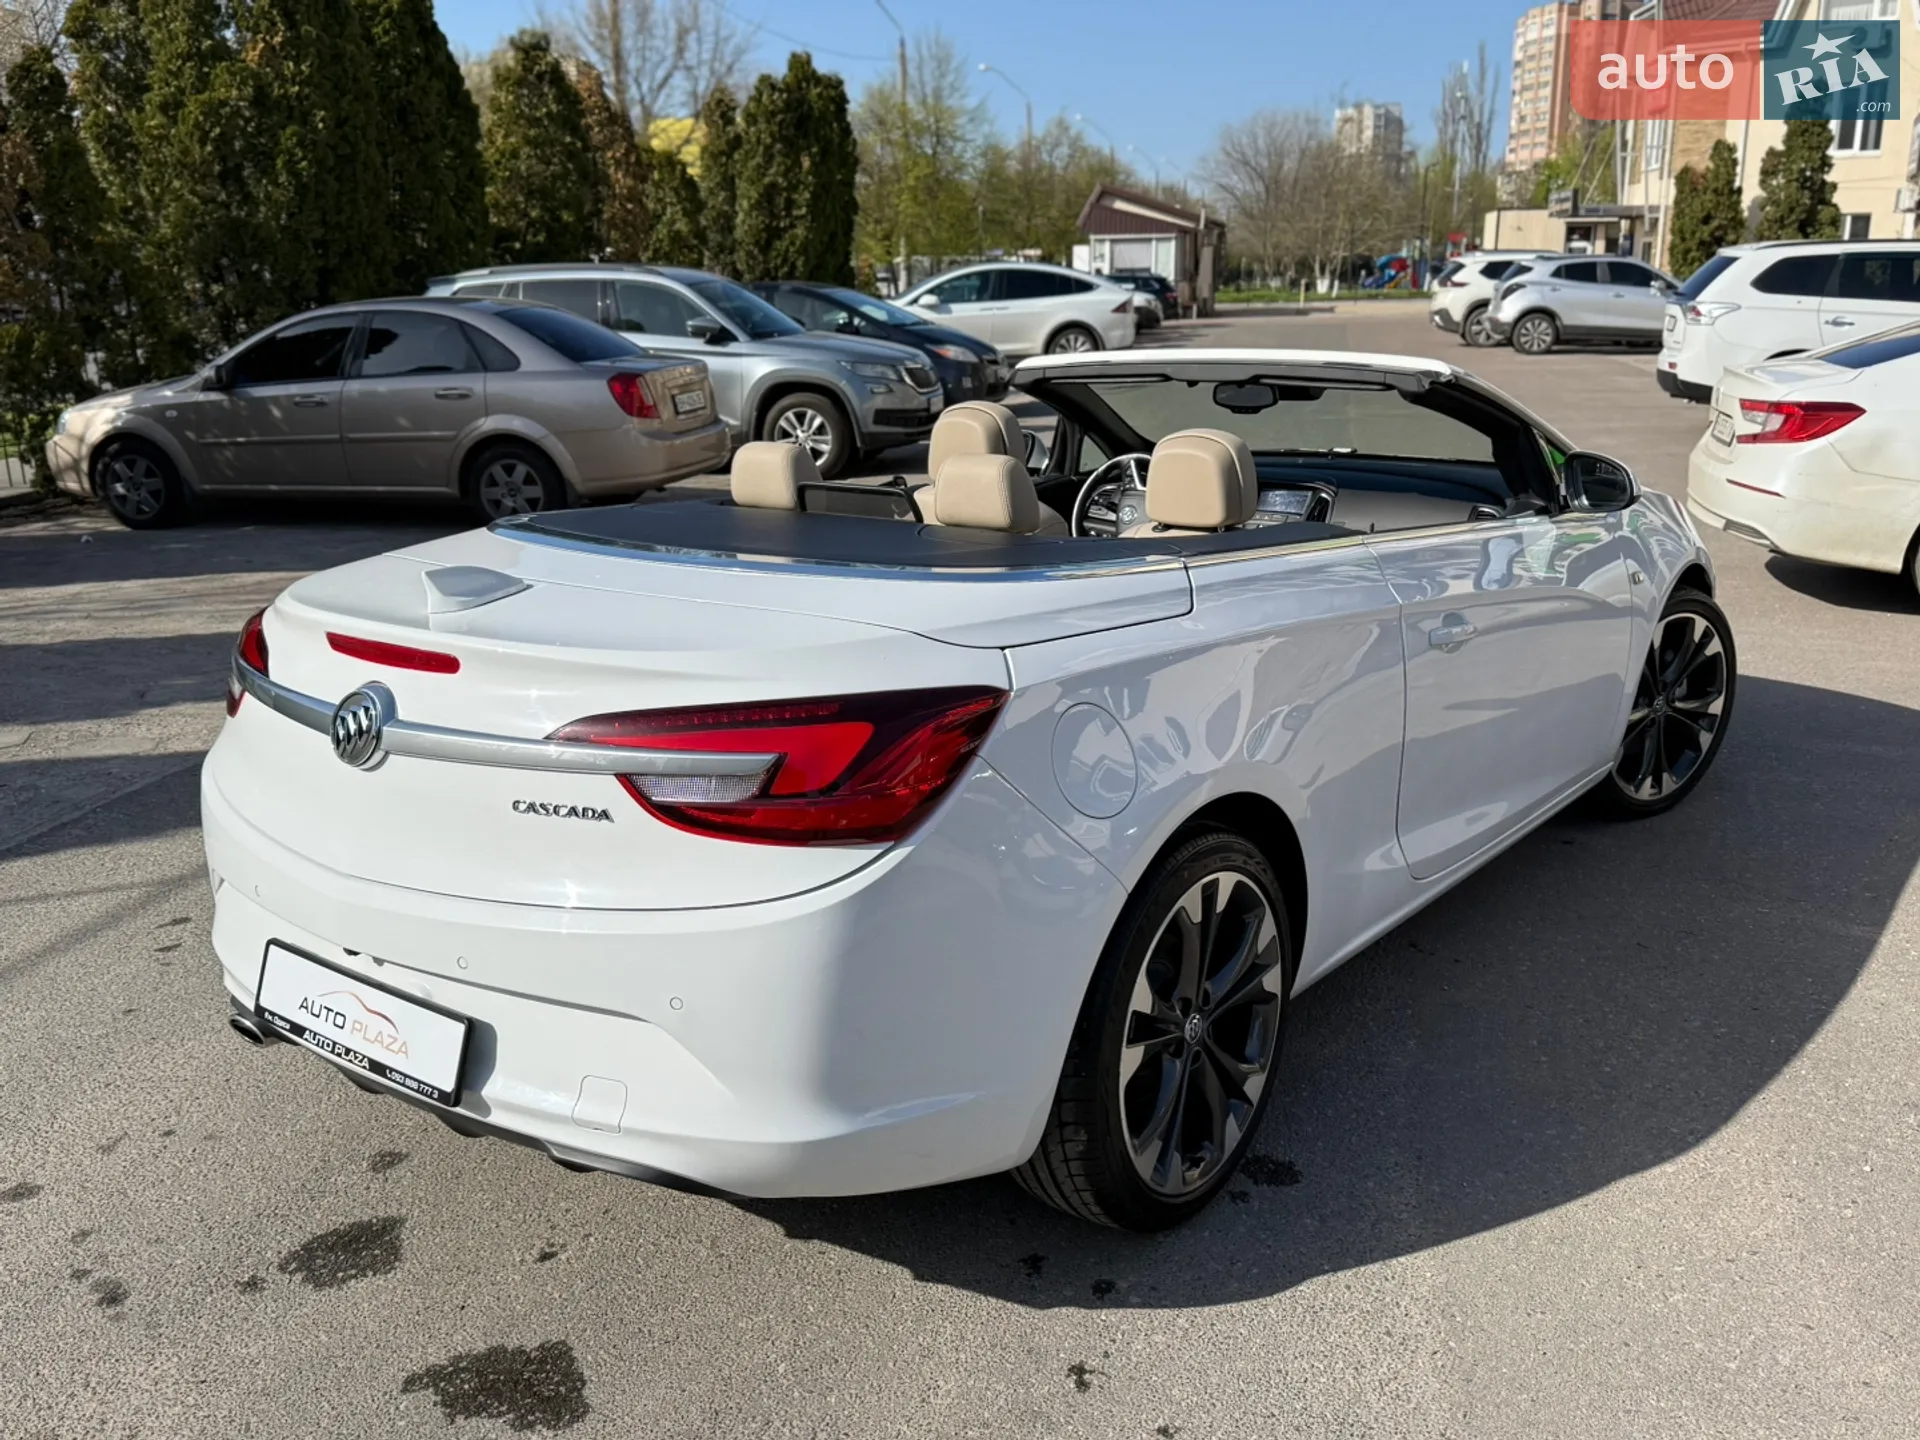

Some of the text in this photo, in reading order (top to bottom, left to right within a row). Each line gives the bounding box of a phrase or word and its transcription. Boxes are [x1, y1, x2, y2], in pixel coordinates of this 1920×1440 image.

[512, 799, 615, 823] CASCADA
[298, 996, 409, 1060] AUTO PLAZA
[303, 1029, 370, 1069] AUTO PLAZA
